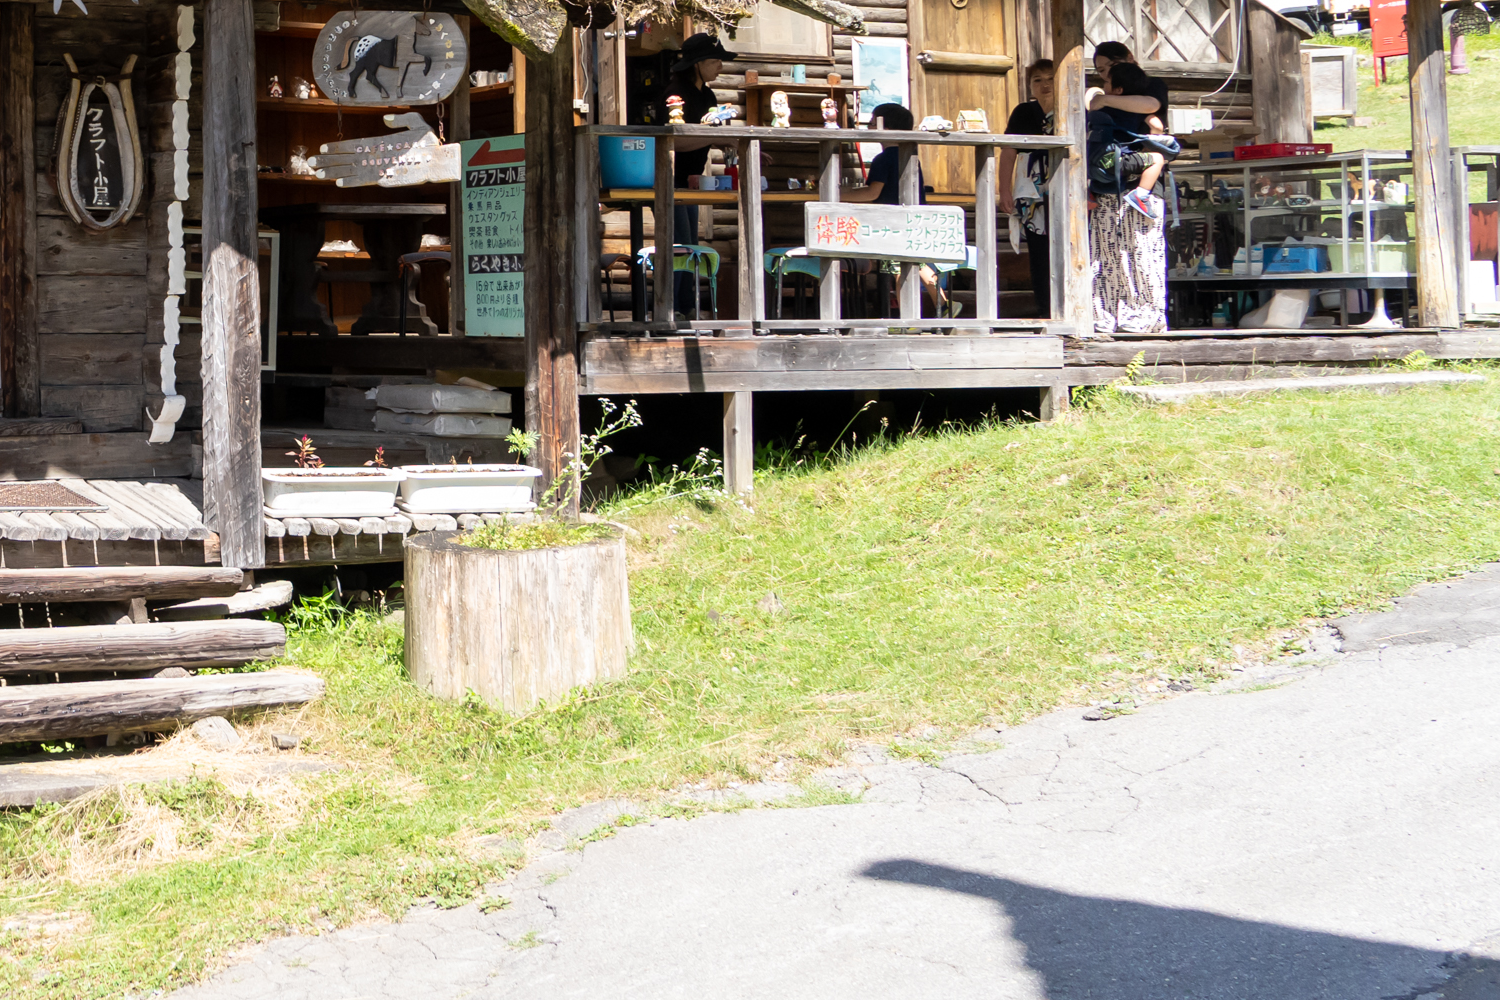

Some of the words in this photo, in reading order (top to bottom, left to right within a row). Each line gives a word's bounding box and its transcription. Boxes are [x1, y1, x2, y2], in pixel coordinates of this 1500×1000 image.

[634, 139, 646, 150] 15
[87, 108, 110, 206] クラフト小屋
[469, 166, 526, 187] クラフト小屋
[471, 255, 524, 272] らくやき小
